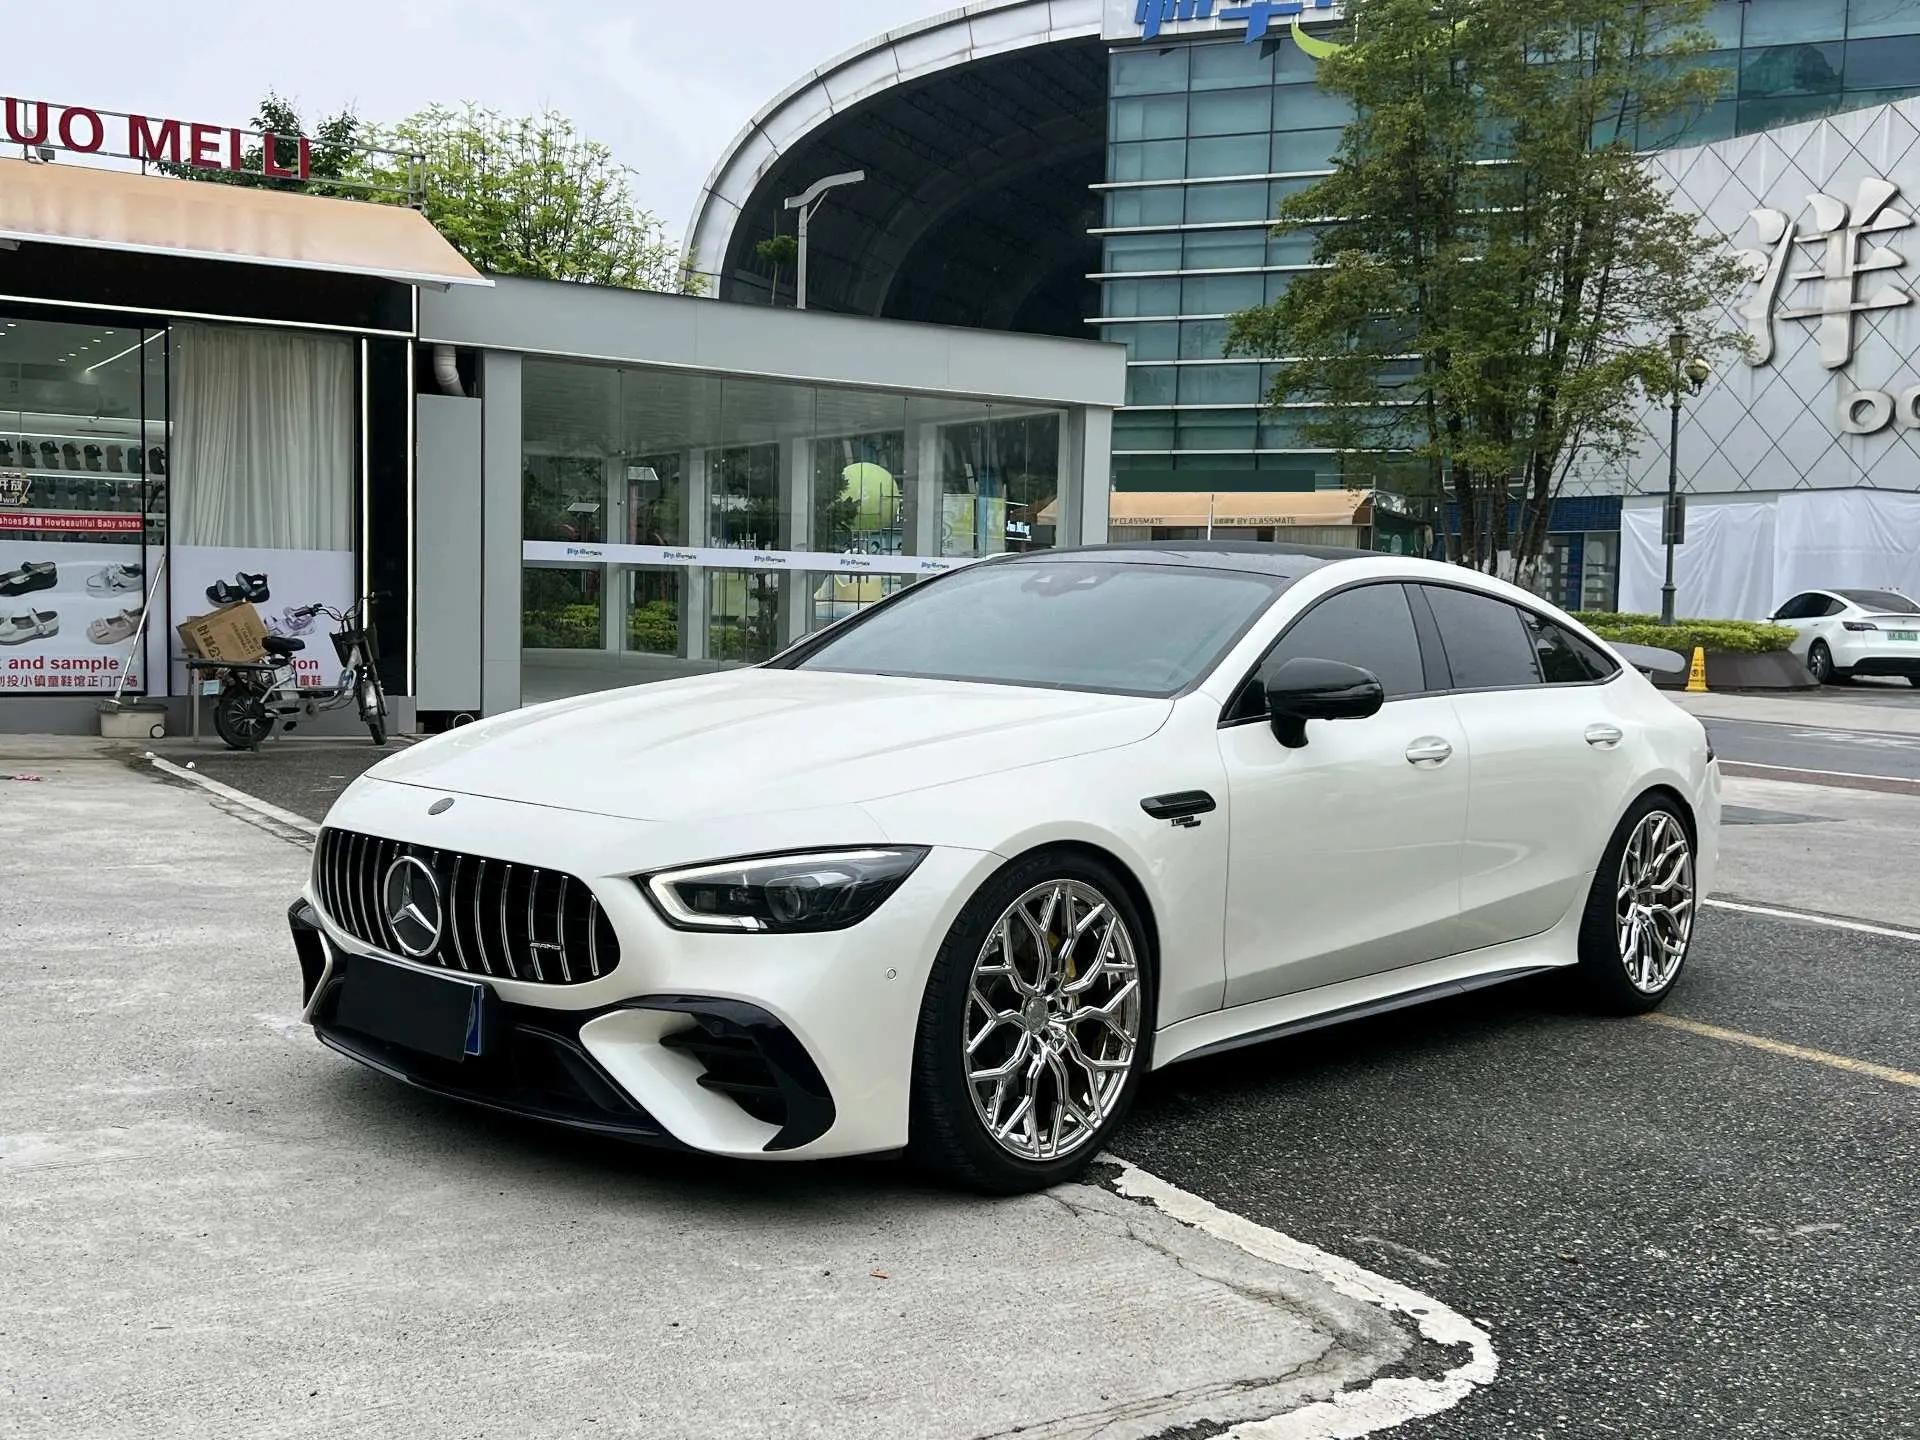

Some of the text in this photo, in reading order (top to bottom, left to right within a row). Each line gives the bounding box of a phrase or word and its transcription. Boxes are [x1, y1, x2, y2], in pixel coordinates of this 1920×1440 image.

[128, 114, 241, 171] MEI
[264, 134, 310, 180] LI
[1733, 177, 1915, 370] 洋
[1249, 516, 1297, 525] CLASSMATE
[8, 655, 119, 673] and sample
